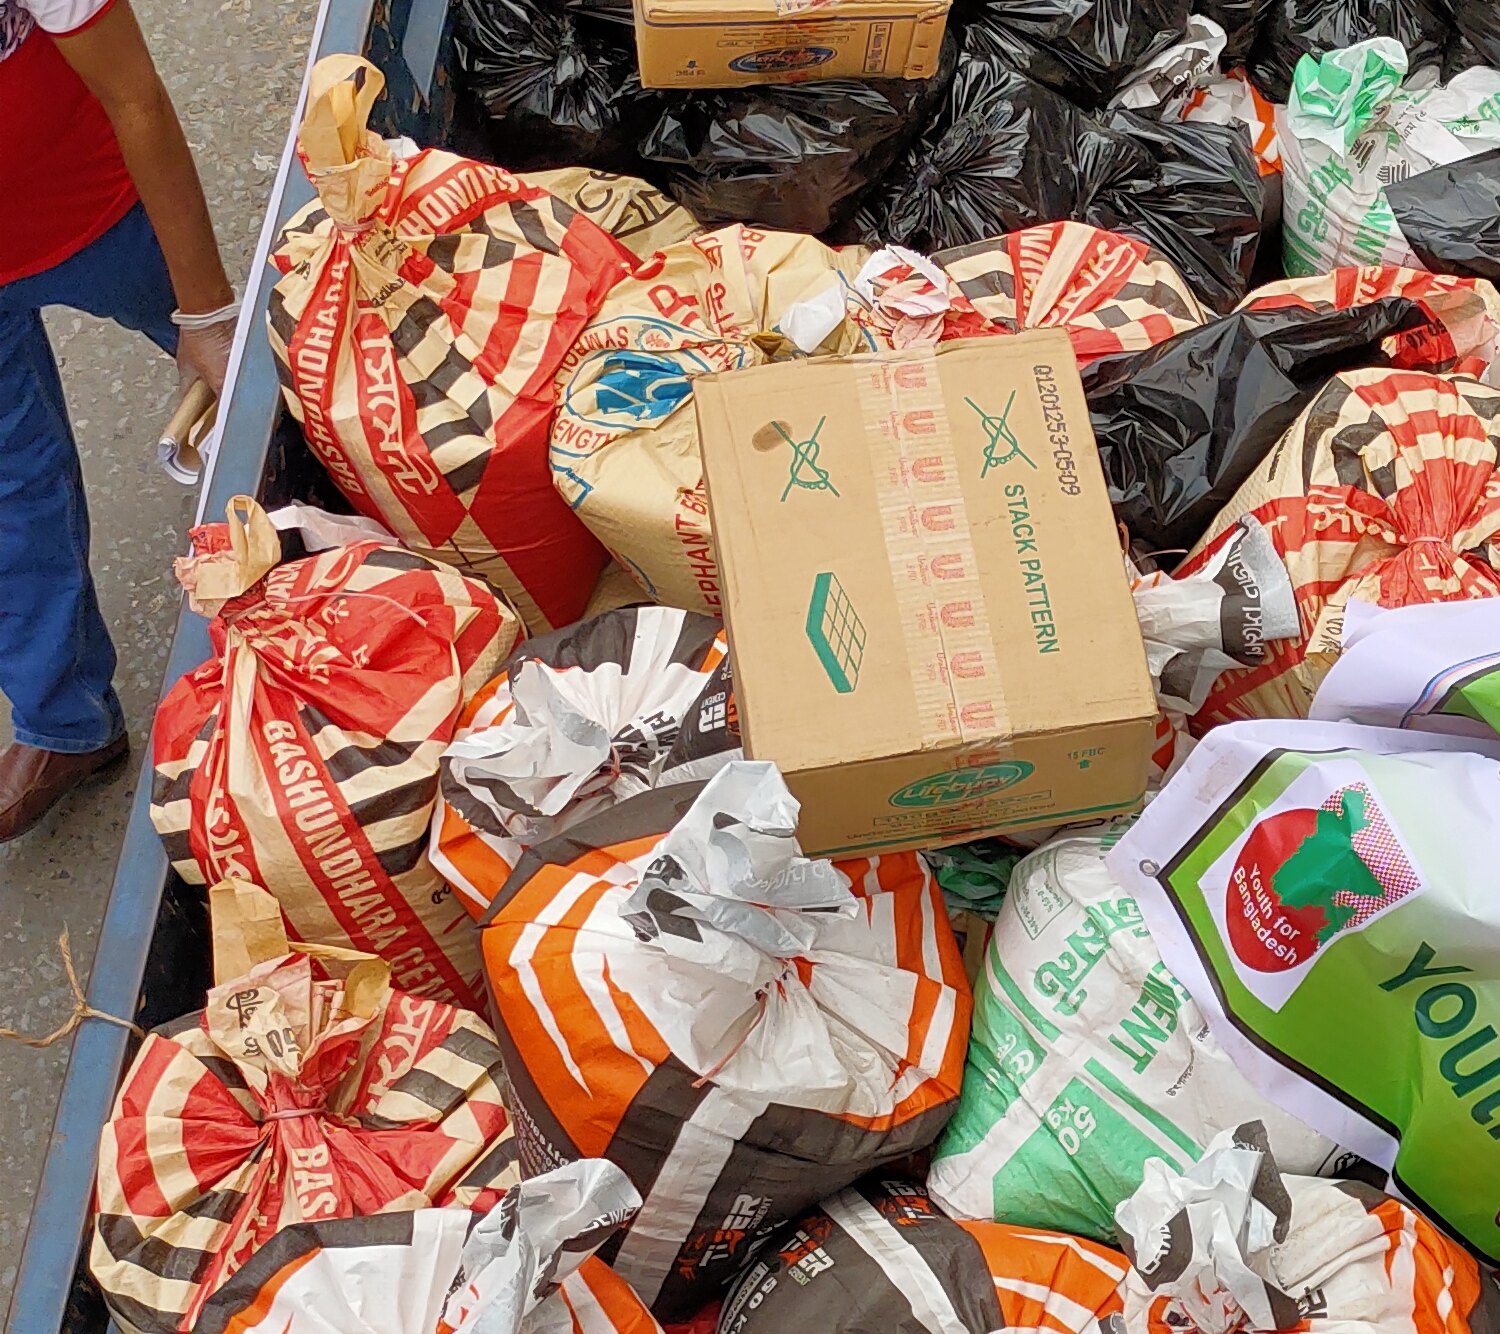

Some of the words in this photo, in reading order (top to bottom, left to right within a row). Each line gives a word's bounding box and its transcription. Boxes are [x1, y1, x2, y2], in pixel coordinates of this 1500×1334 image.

[1003, 482, 1039, 556] STACK
[1019, 557, 1061, 656] PATTERN
[262, 719, 410, 952] BASHUNDHARA
[1232, 865, 1299, 966] Bangladesh
[1248, 862, 1274, 921] Youth
[1272, 913, 1301, 941] for
[1056, 1103, 1098, 1156] 50
